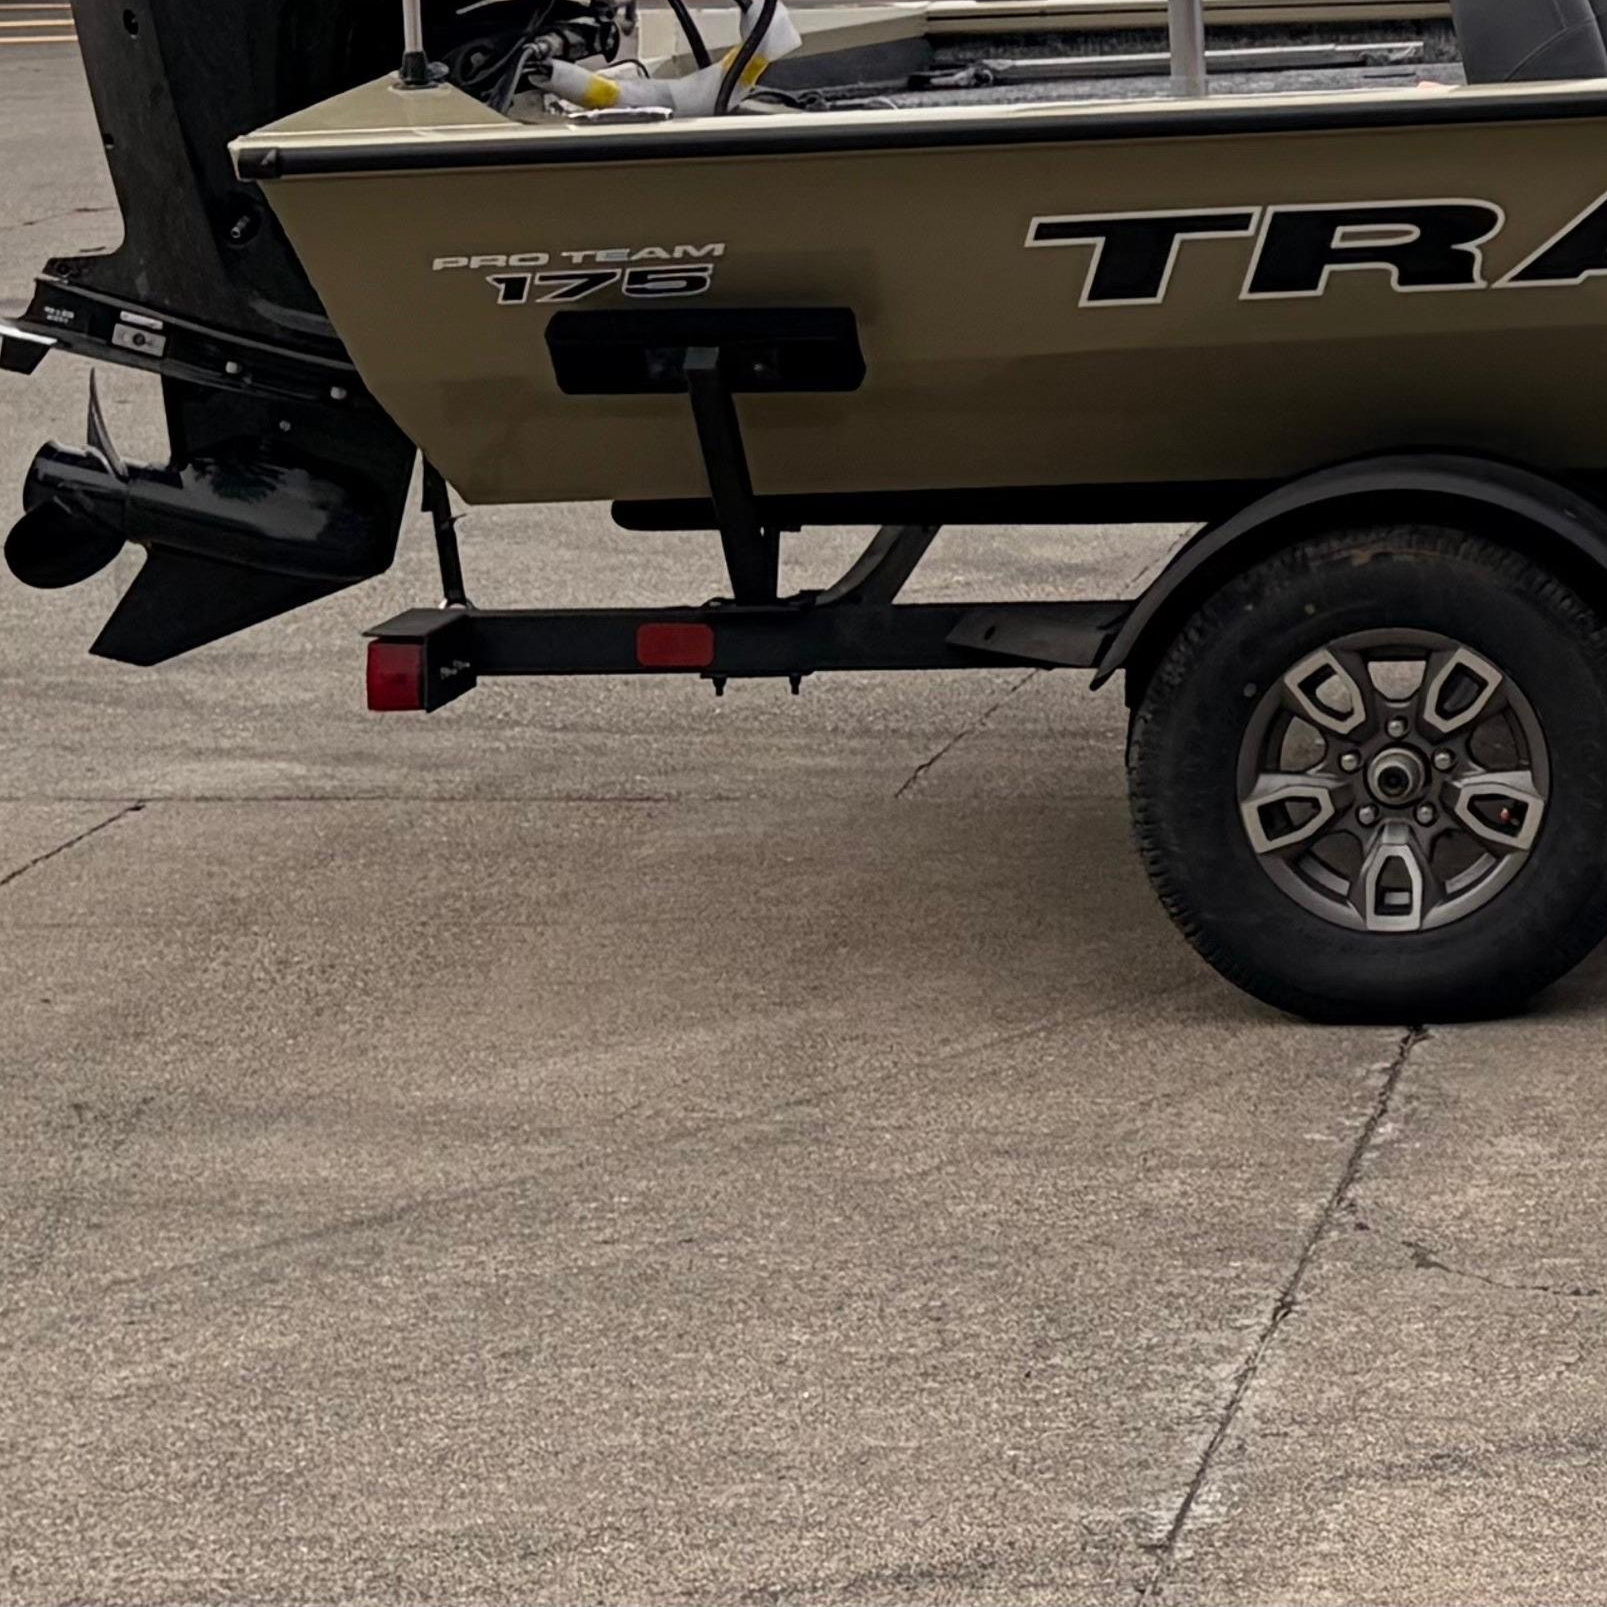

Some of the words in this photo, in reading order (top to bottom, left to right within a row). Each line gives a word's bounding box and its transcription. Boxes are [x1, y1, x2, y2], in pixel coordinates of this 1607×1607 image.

[432, 252, 549, 270] PRO
[561, 243, 726, 264] TEAM
[486, 263, 714, 305] 175
